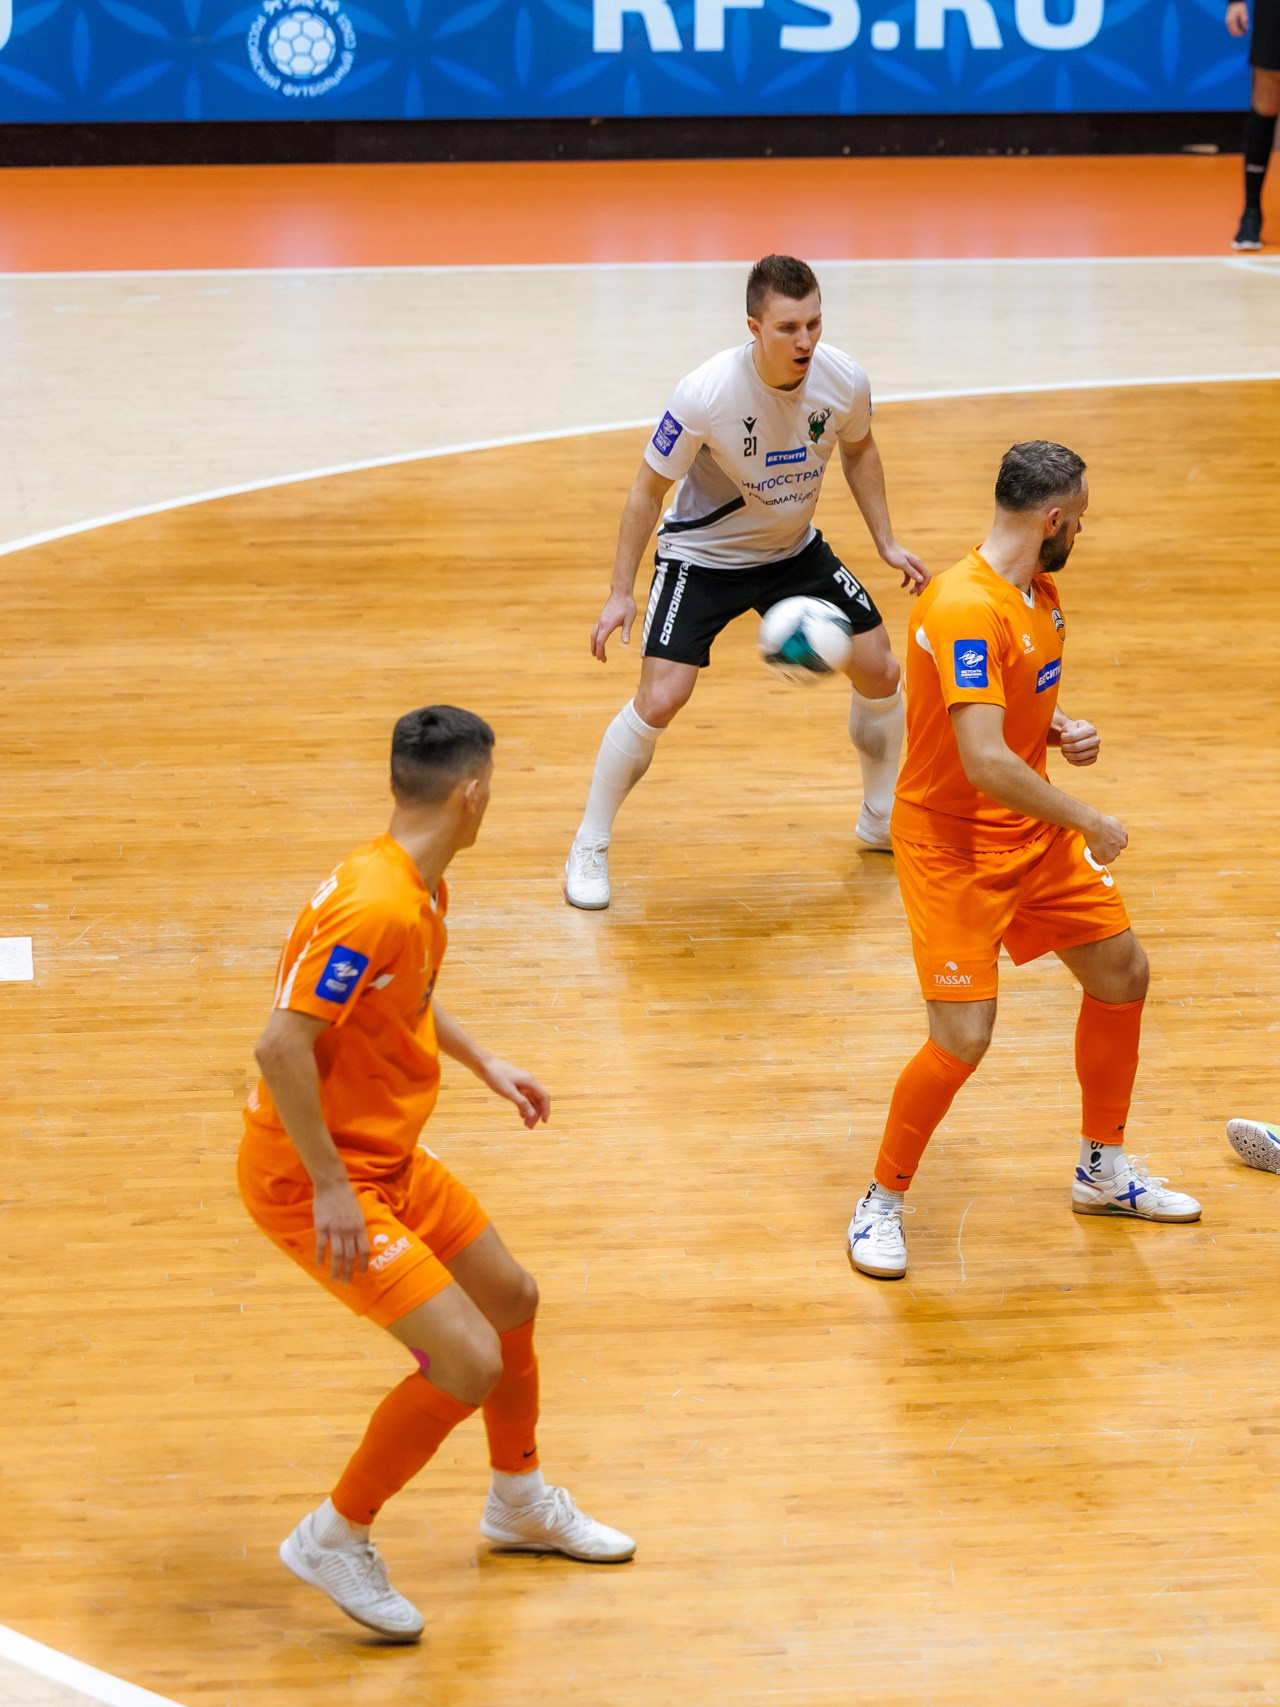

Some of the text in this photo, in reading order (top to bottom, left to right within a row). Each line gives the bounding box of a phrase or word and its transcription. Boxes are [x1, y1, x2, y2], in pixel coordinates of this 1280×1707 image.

[743, 436, 758, 457] 21
[766, 451, 806, 463] БЕТСИТИ
[659, 571, 689, 646] CORDIANT
[933, 974, 973, 985] TASSAY
